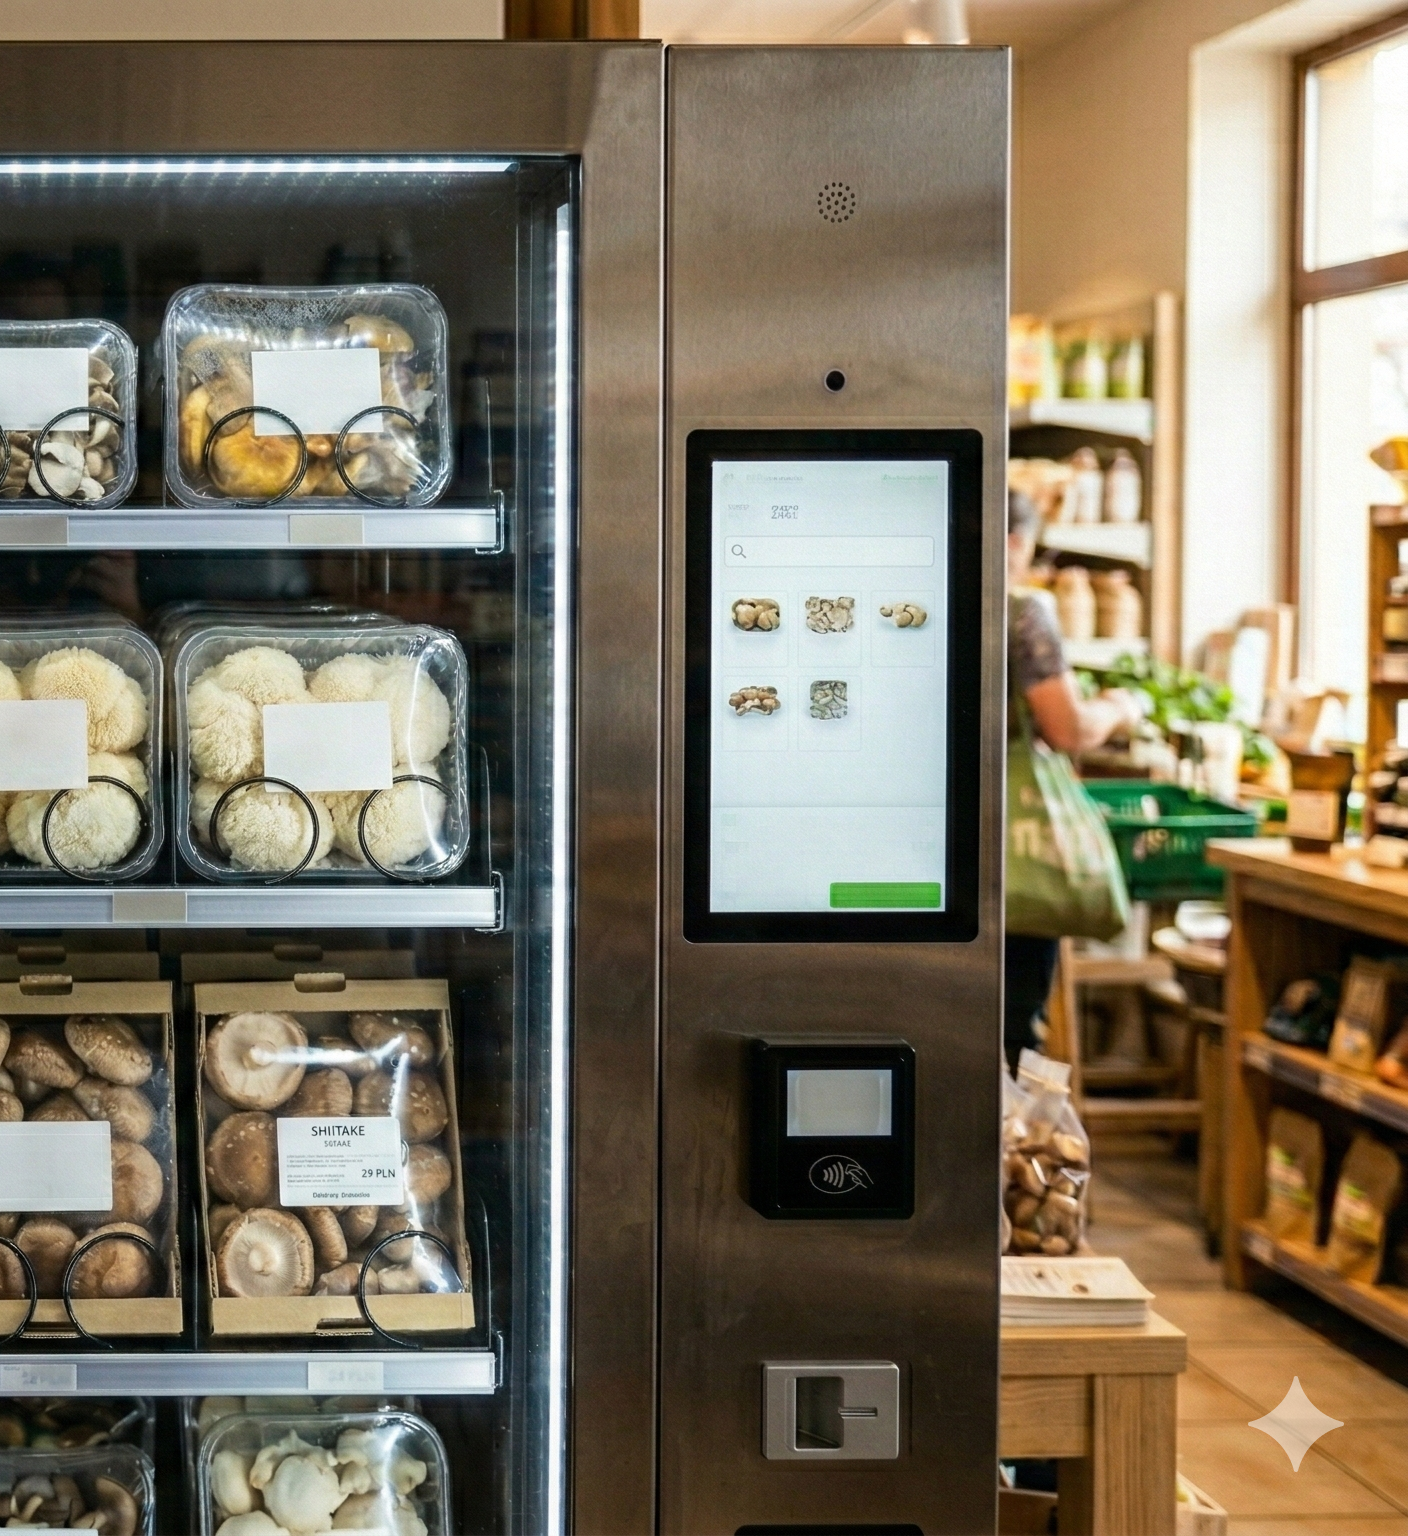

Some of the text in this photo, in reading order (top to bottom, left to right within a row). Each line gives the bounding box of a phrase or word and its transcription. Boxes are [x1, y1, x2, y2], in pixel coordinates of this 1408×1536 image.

[311, 1125, 365, 1137] SHIITAKE
[361, 1168, 396, 1178] 29 PLN
